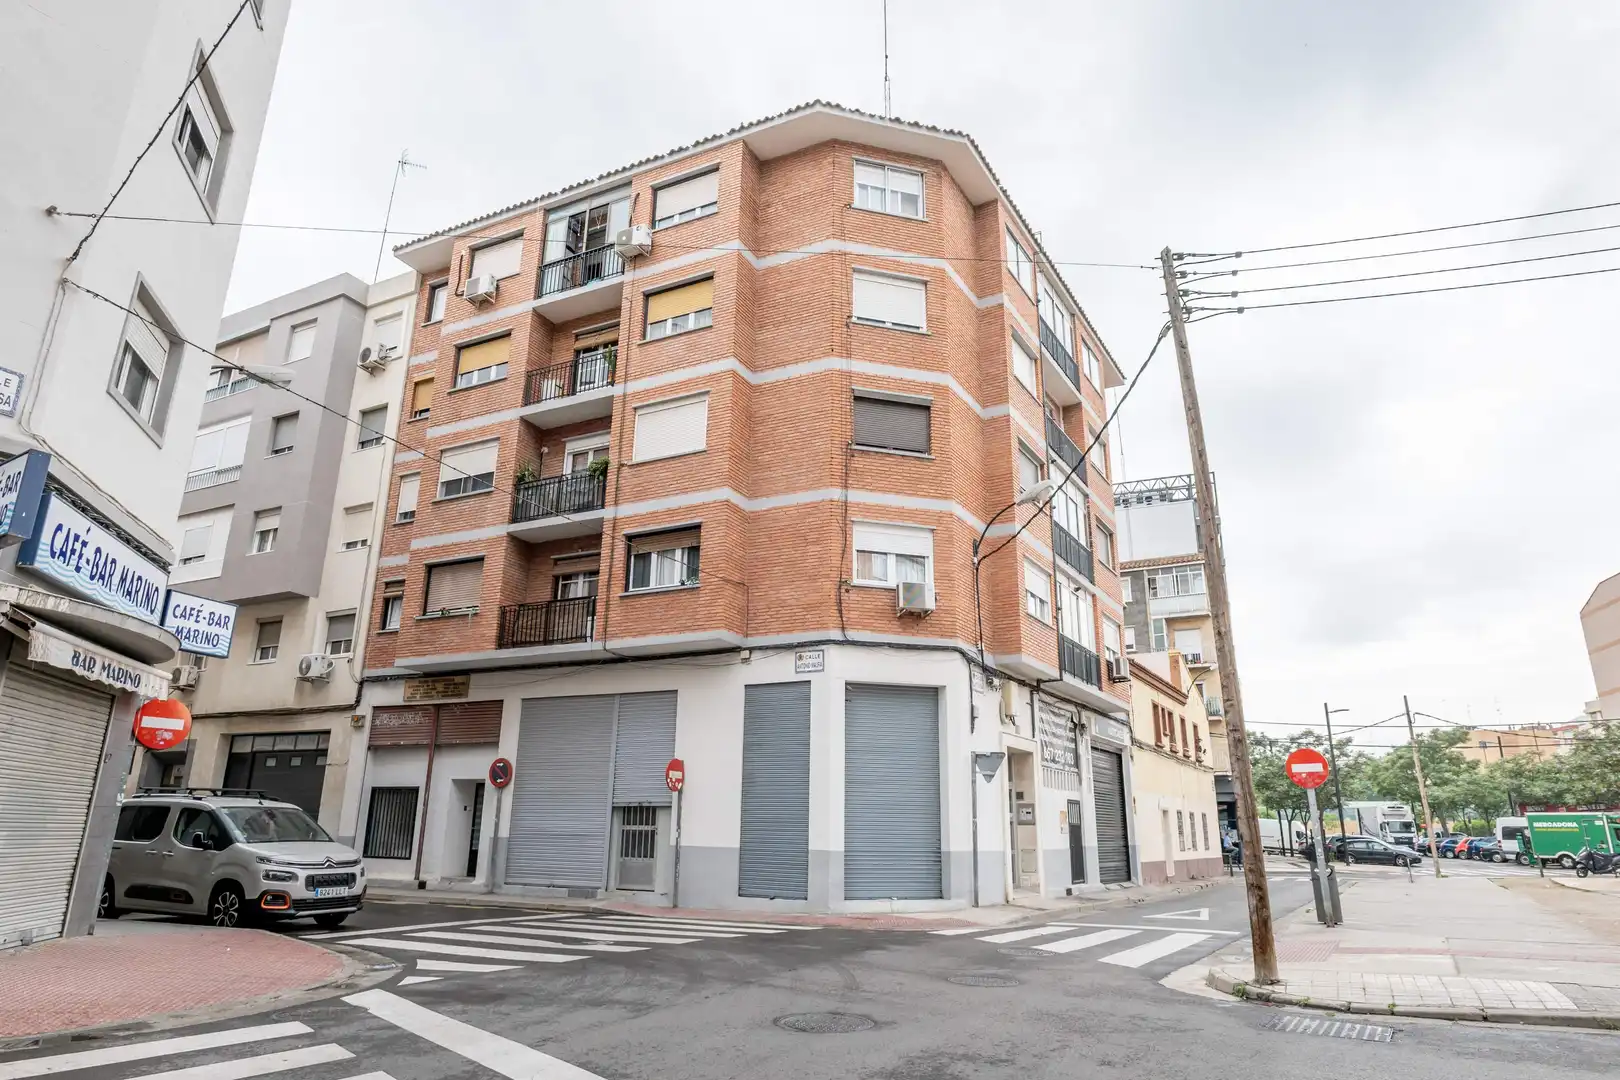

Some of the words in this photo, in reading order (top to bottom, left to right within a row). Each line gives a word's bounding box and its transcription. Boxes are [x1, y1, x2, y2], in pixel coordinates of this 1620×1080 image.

[49, 523, 117, 593] CAFÉ-BAR
[116, 565, 159, 616] MARINO
[172, 603, 231, 631] CAFÉ-BAR
[174, 625, 220, 648] MARINO
[71, 649, 97, 674] BAR
[100, 661, 141, 689] MARINO
